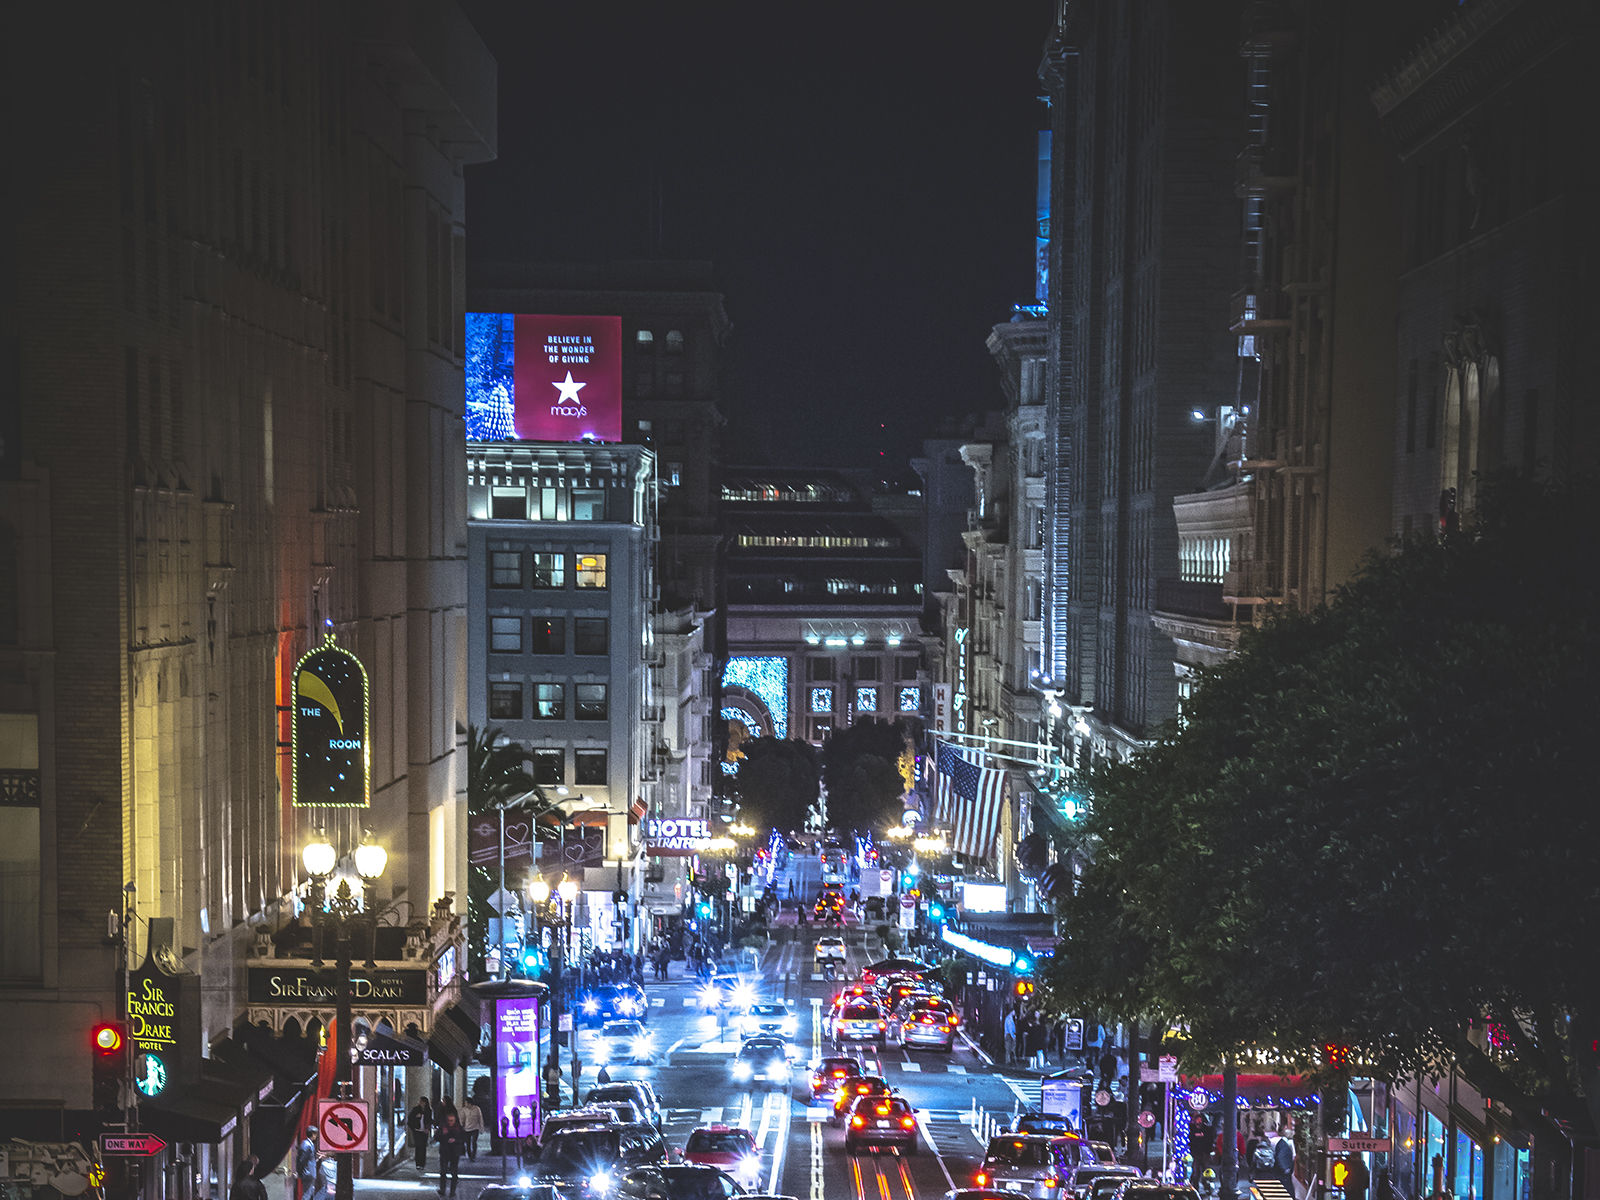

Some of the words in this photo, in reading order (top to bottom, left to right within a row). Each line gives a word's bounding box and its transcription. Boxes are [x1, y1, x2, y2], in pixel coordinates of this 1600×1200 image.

[547, 335, 580, 343] BELIEVE
[543, 345, 559, 353] THE
[561, 345, 595, 353] WONDER
[548, 355, 559, 363] OF
[561, 355, 590, 363] GIVING
[300, 707, 321, 716] THE
[329, 739, 361, 749] ROOM
[648, 819, 712, 837] HOTEL
[127, 991, 175, 1017] FRANCIS
[130, 1013, 172, 1039] DRAKE
[139, 1041, 164, 1052] HOTEL
[363, 1049, 410, 1061] SCALA'S
[107, 1140, 125, 1149] ONE
[128, 1140, 146, 1149] WAY
[1342, 1141, 1378, 1149] Sutter
